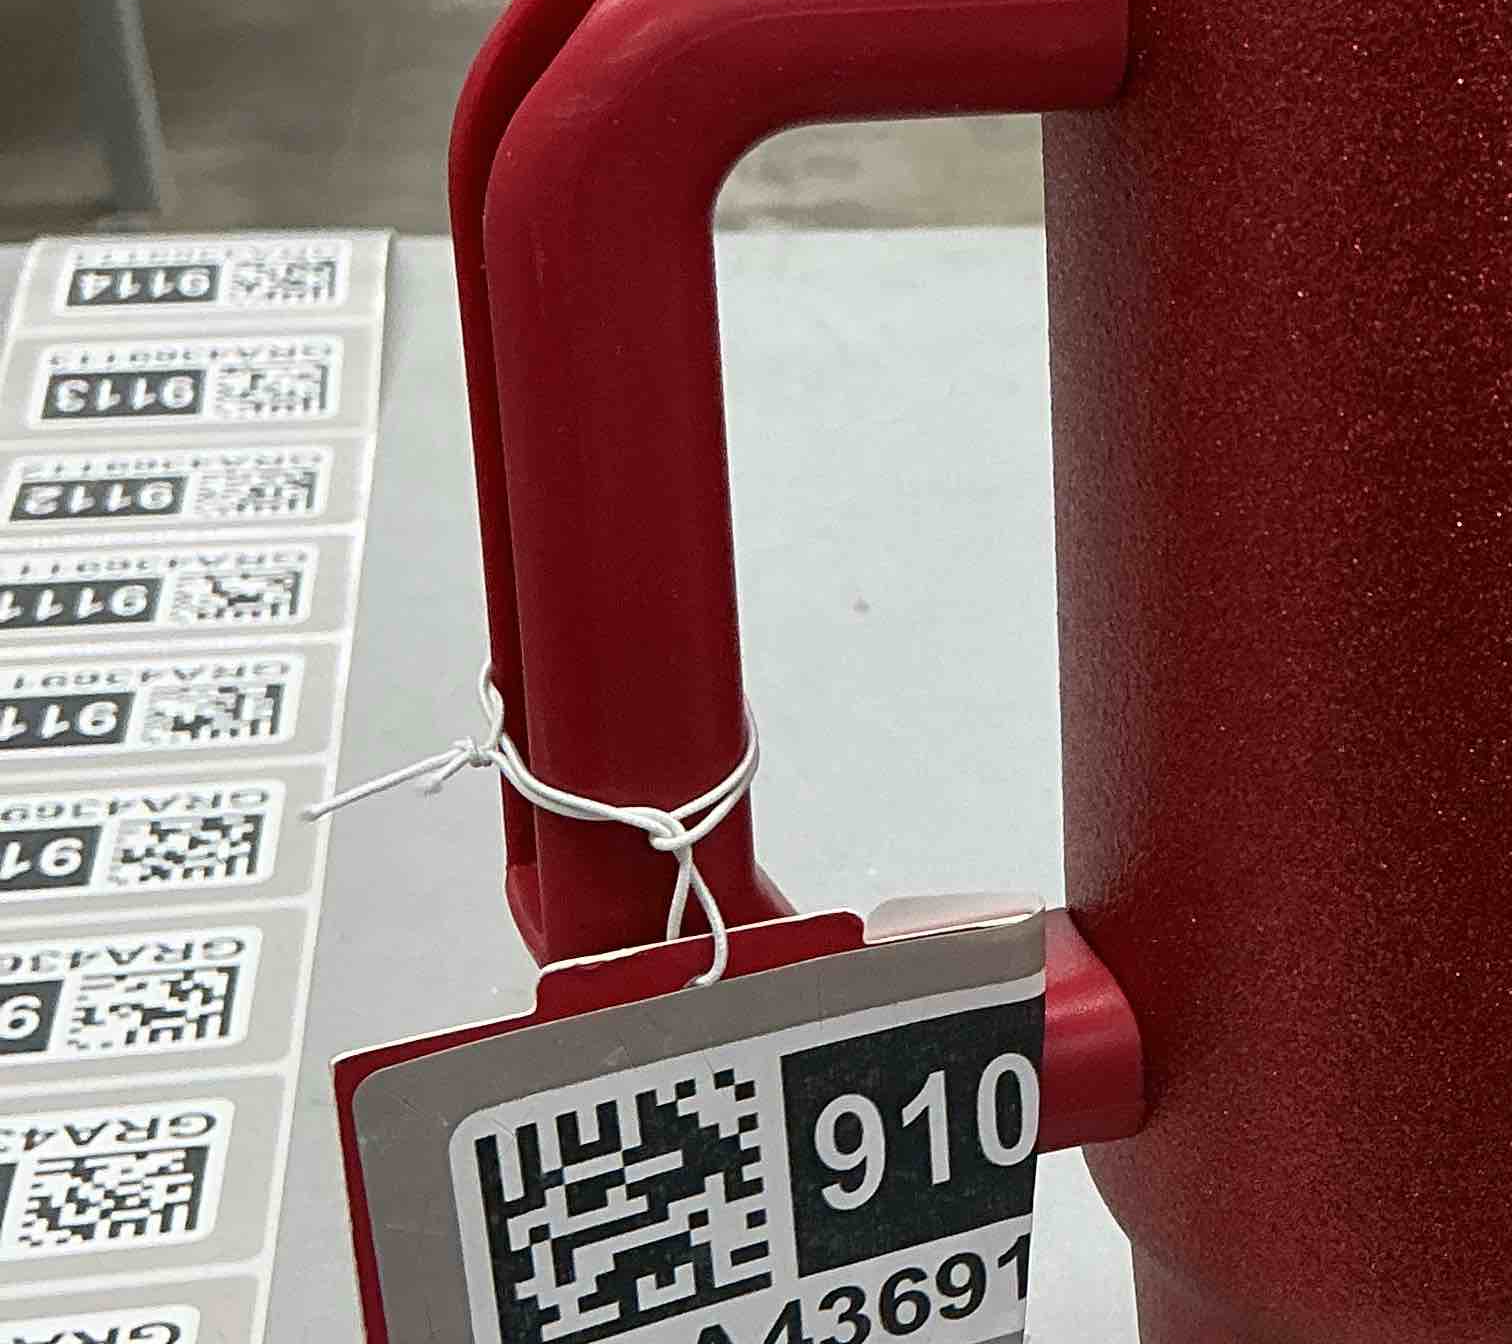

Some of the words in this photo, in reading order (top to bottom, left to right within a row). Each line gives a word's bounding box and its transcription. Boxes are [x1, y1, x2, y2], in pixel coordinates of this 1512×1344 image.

[78, 267, 211, 301] 9114
[56, 375, 195, 413] 9113
[24, 480, 174, 515] 9112
[0, 701, 119, 741] 911
[0, 836, 83, 881] 91
[0, 994, 42, 1041] 9
[815, 1053, 1040, 1210] 910
